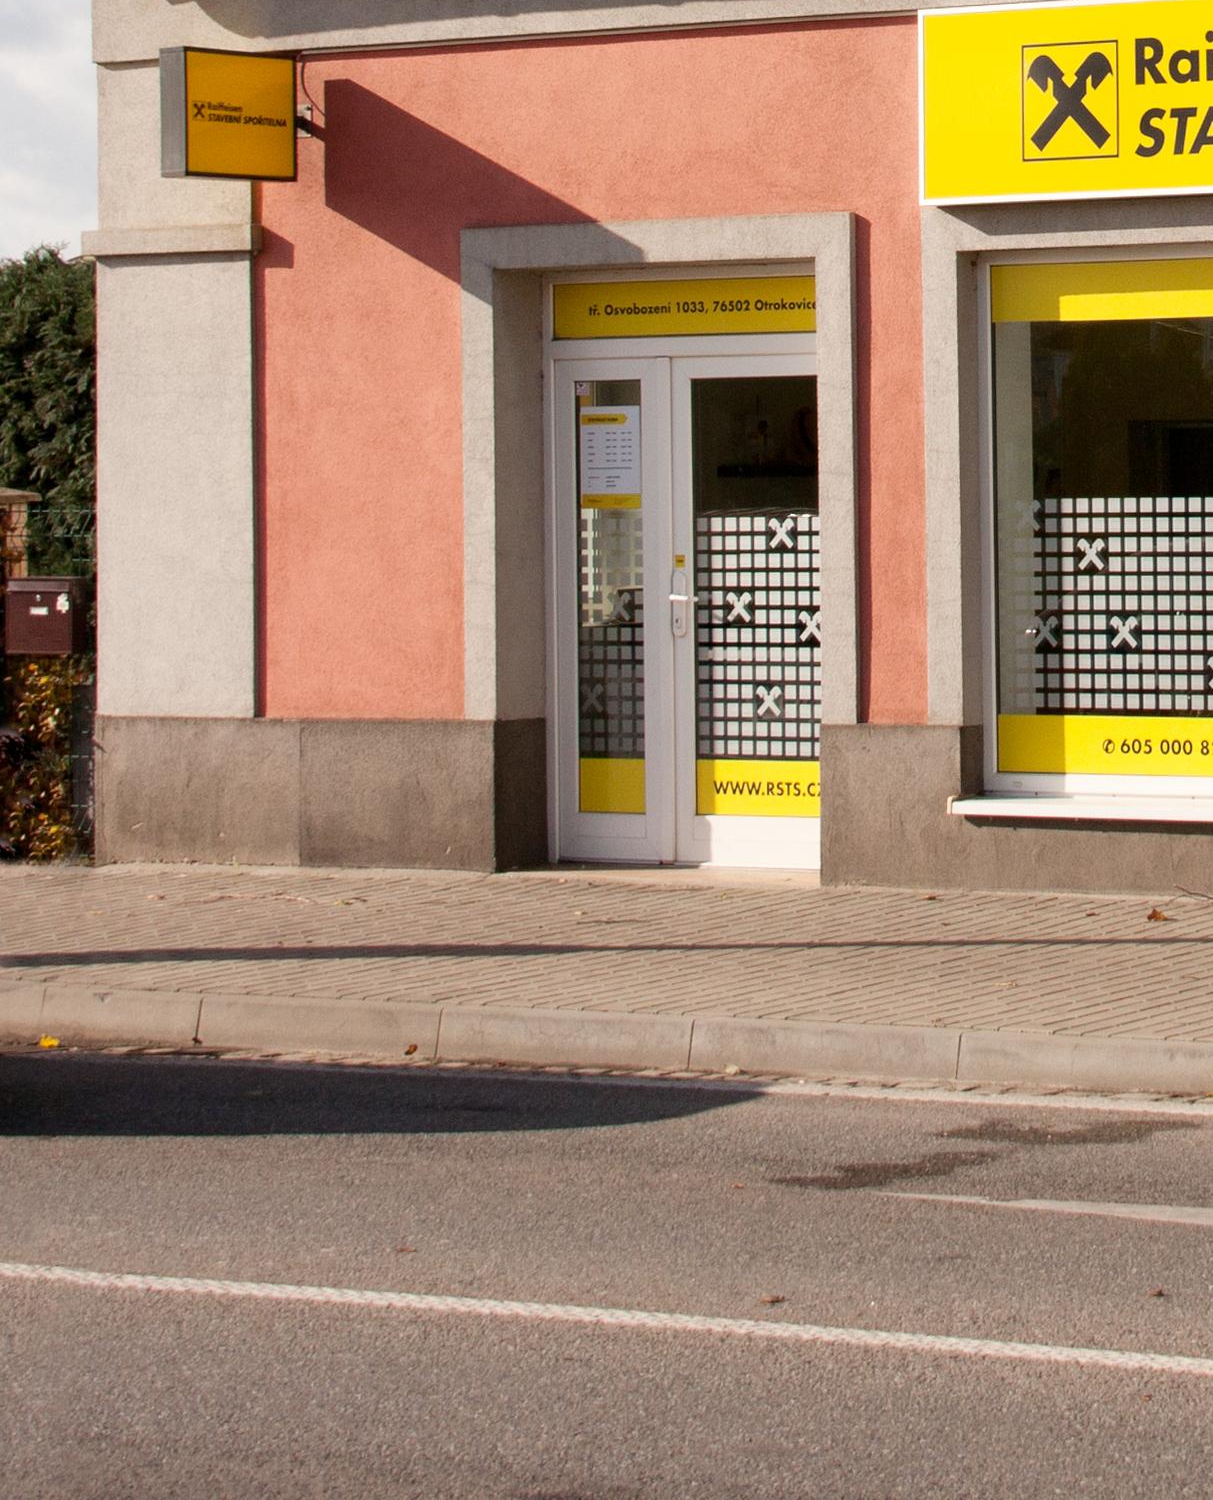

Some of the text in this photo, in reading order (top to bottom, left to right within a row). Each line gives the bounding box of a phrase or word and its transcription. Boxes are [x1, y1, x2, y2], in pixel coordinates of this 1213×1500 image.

[207, 113, 287, 127] STAVEBNÍ SPOŘITELNA
[604, 301, 671, 315] Osvobození
[675, 301, 709, 314] 1033,
[713, 299, 750, 312] 76502
[1120, 739, 1153, 755] 605
[1159, 739, 1193, 756] 000
